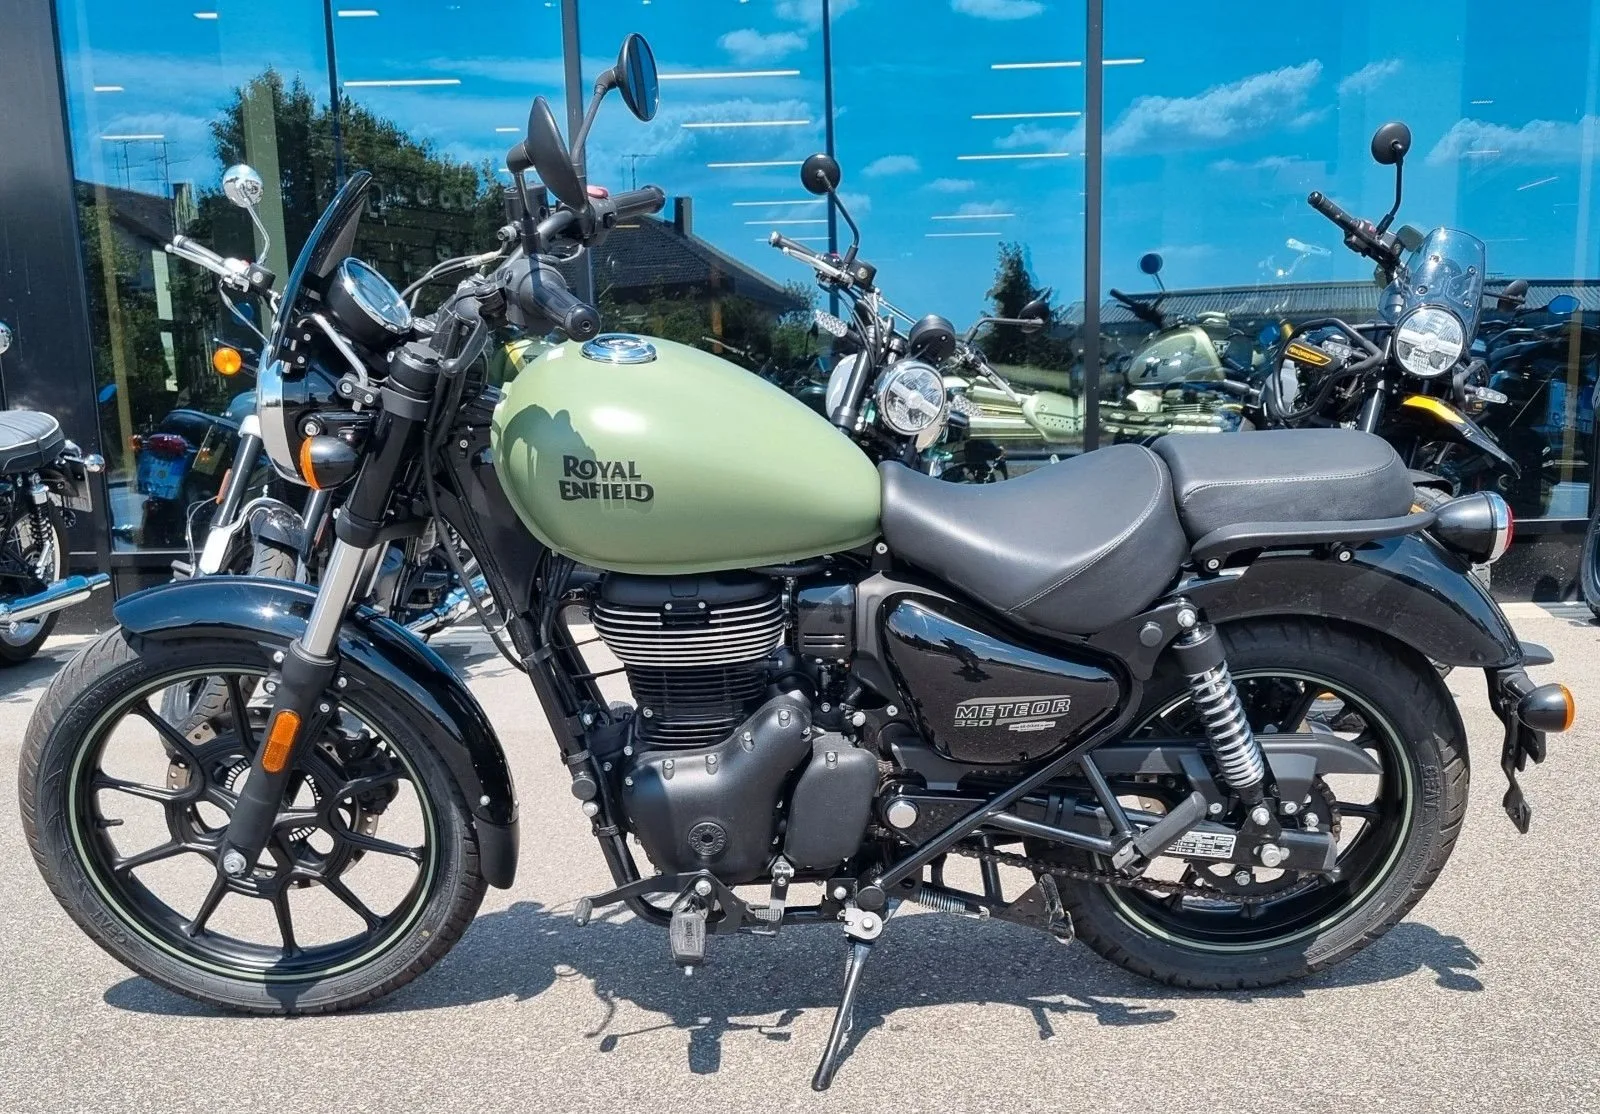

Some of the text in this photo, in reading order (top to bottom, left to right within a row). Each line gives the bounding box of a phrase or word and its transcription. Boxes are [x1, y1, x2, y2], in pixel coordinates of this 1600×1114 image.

[563, 455, 641, 479] ROYAL
[559, 480, 654, 502] ENFIELD
[955, 698, 1071, 719] METEOR
[953, 719, 993, 727] 350
